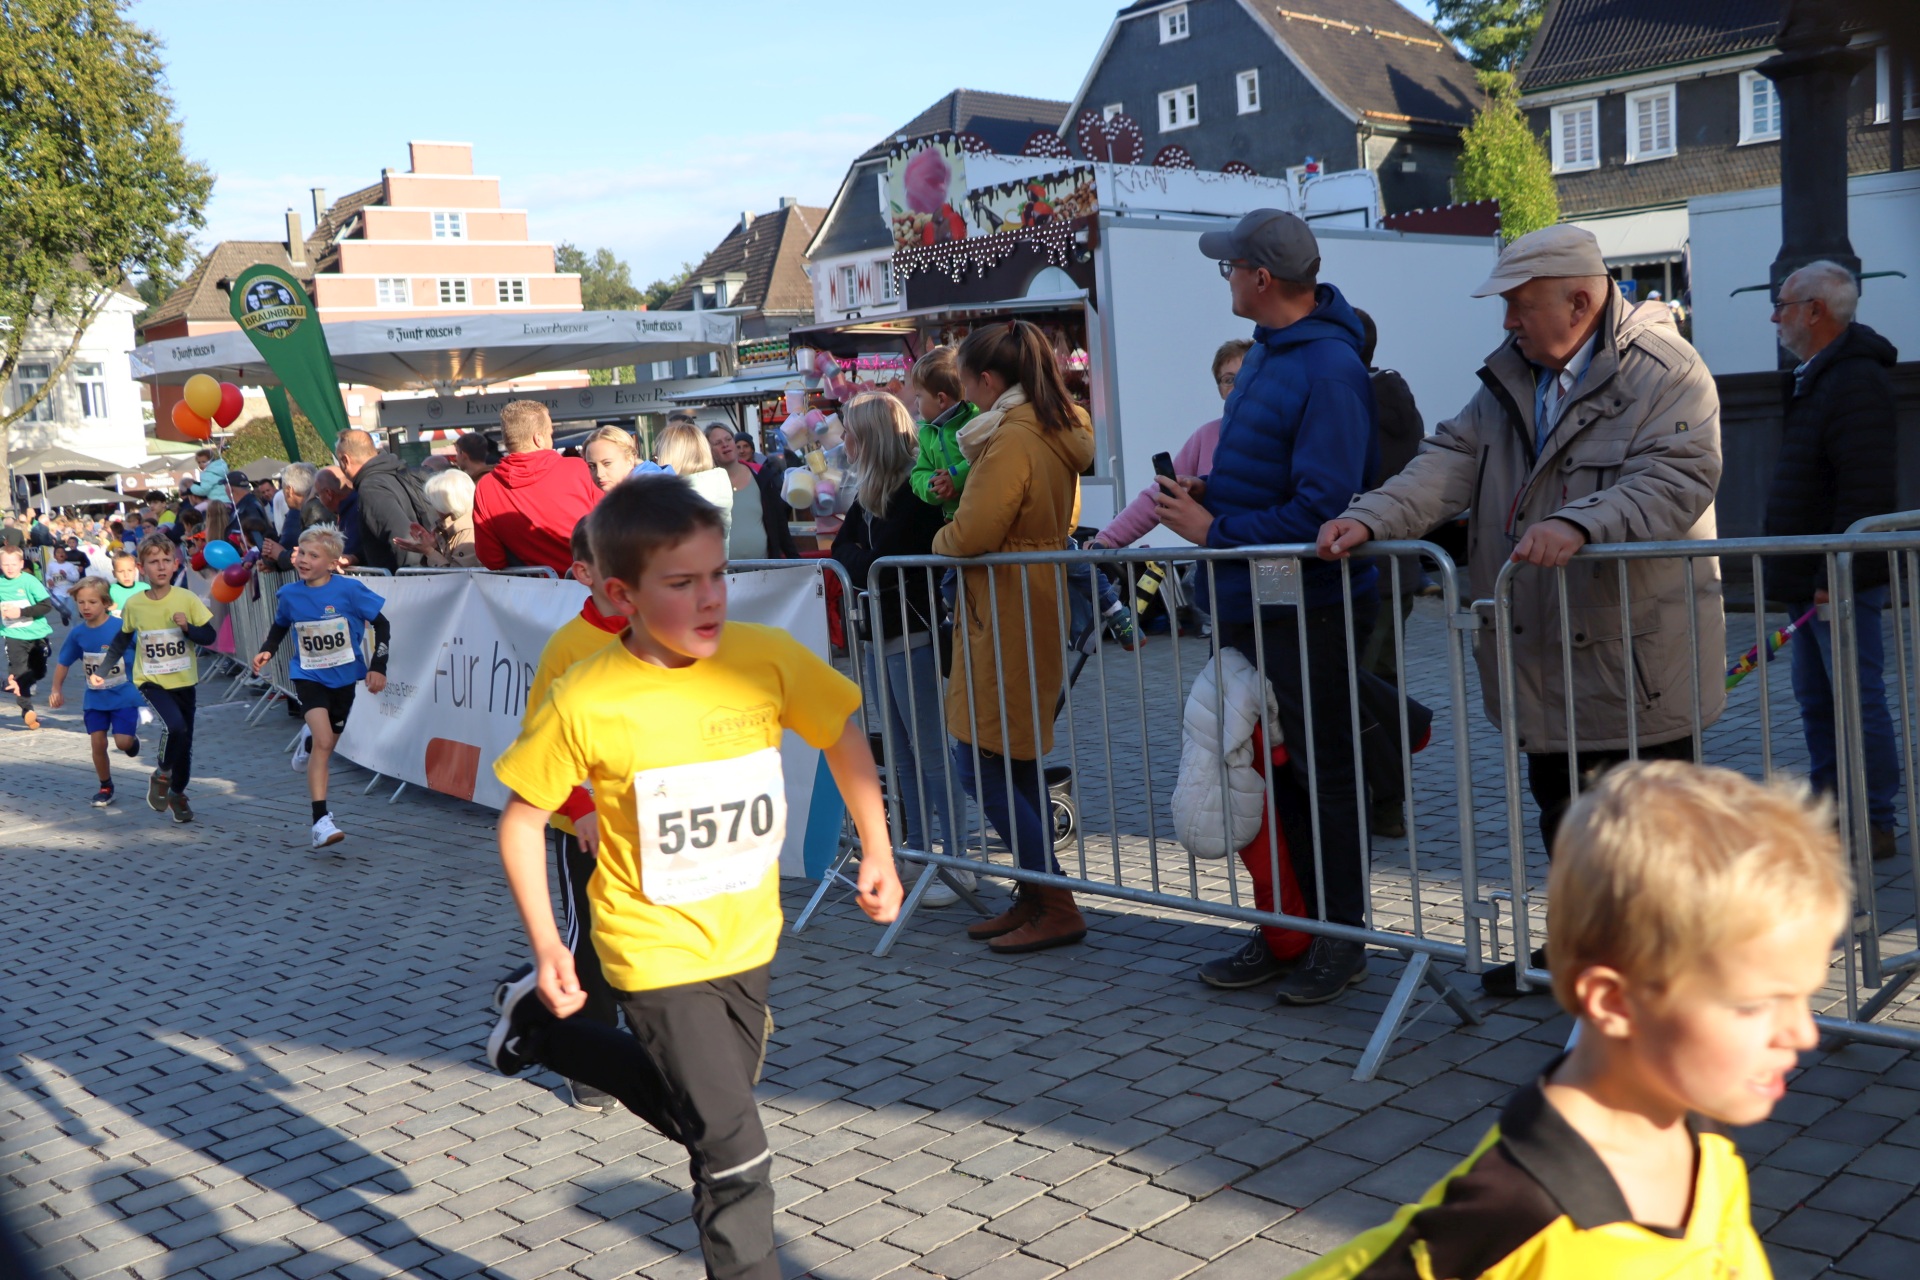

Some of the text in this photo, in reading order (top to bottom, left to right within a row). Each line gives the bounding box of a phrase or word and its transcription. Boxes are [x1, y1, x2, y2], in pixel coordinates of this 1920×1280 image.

[245, 304, 304, 326] BRAUNBRÄU
[425, 325, 454, 339] KÖLSCH
[145, 640, 186, 659] 5568
[302, 631, 346, 652] 5098
[84, 663, 121, 677] 505
[433, 637, 480, 709] Für
[657, 793, 774, 855] 5570
